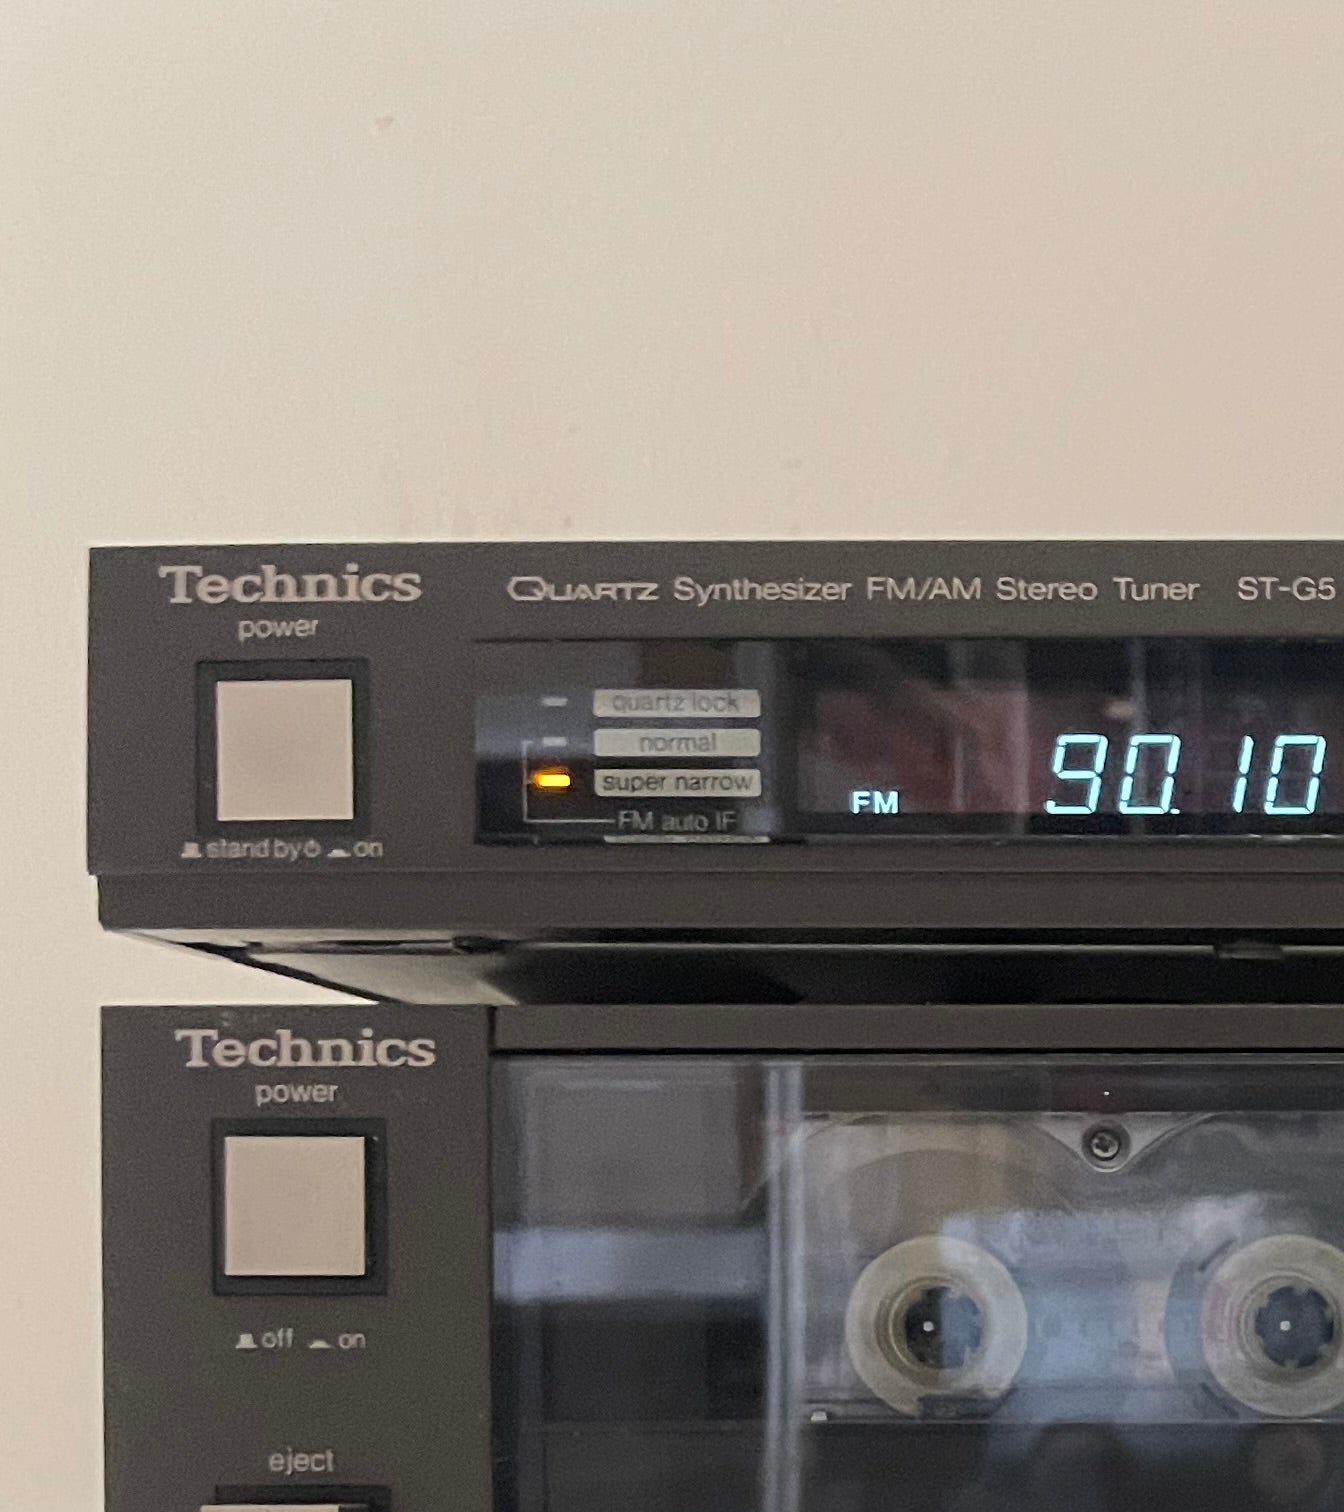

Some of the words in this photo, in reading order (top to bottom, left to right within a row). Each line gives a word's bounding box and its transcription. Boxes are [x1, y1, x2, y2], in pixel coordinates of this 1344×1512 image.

[158, 564, 422, 603] Technics
[673, 576, 852, 607] Synthesizer
[866, 576, 982, 600] FM/AM
[996, 576, 1098, 601] Stereo
[1112, 576, 1200, 602] Tuner
[1237, 576, 1336, 602] ST-G5
[238, 618, 318, 642] power
[640, 732, 716, 752] normal
[603, 774, 666, 794] super
[674, 774, 752, 792] narrow
[1044, 733, 1326, 815] 90.10
[850, 790, 899, 814] FM
[174, 1028, 436, 1068] Technics
[255, 1083, 338, 1106] power
[268, 1448, 334, 1476] eject
